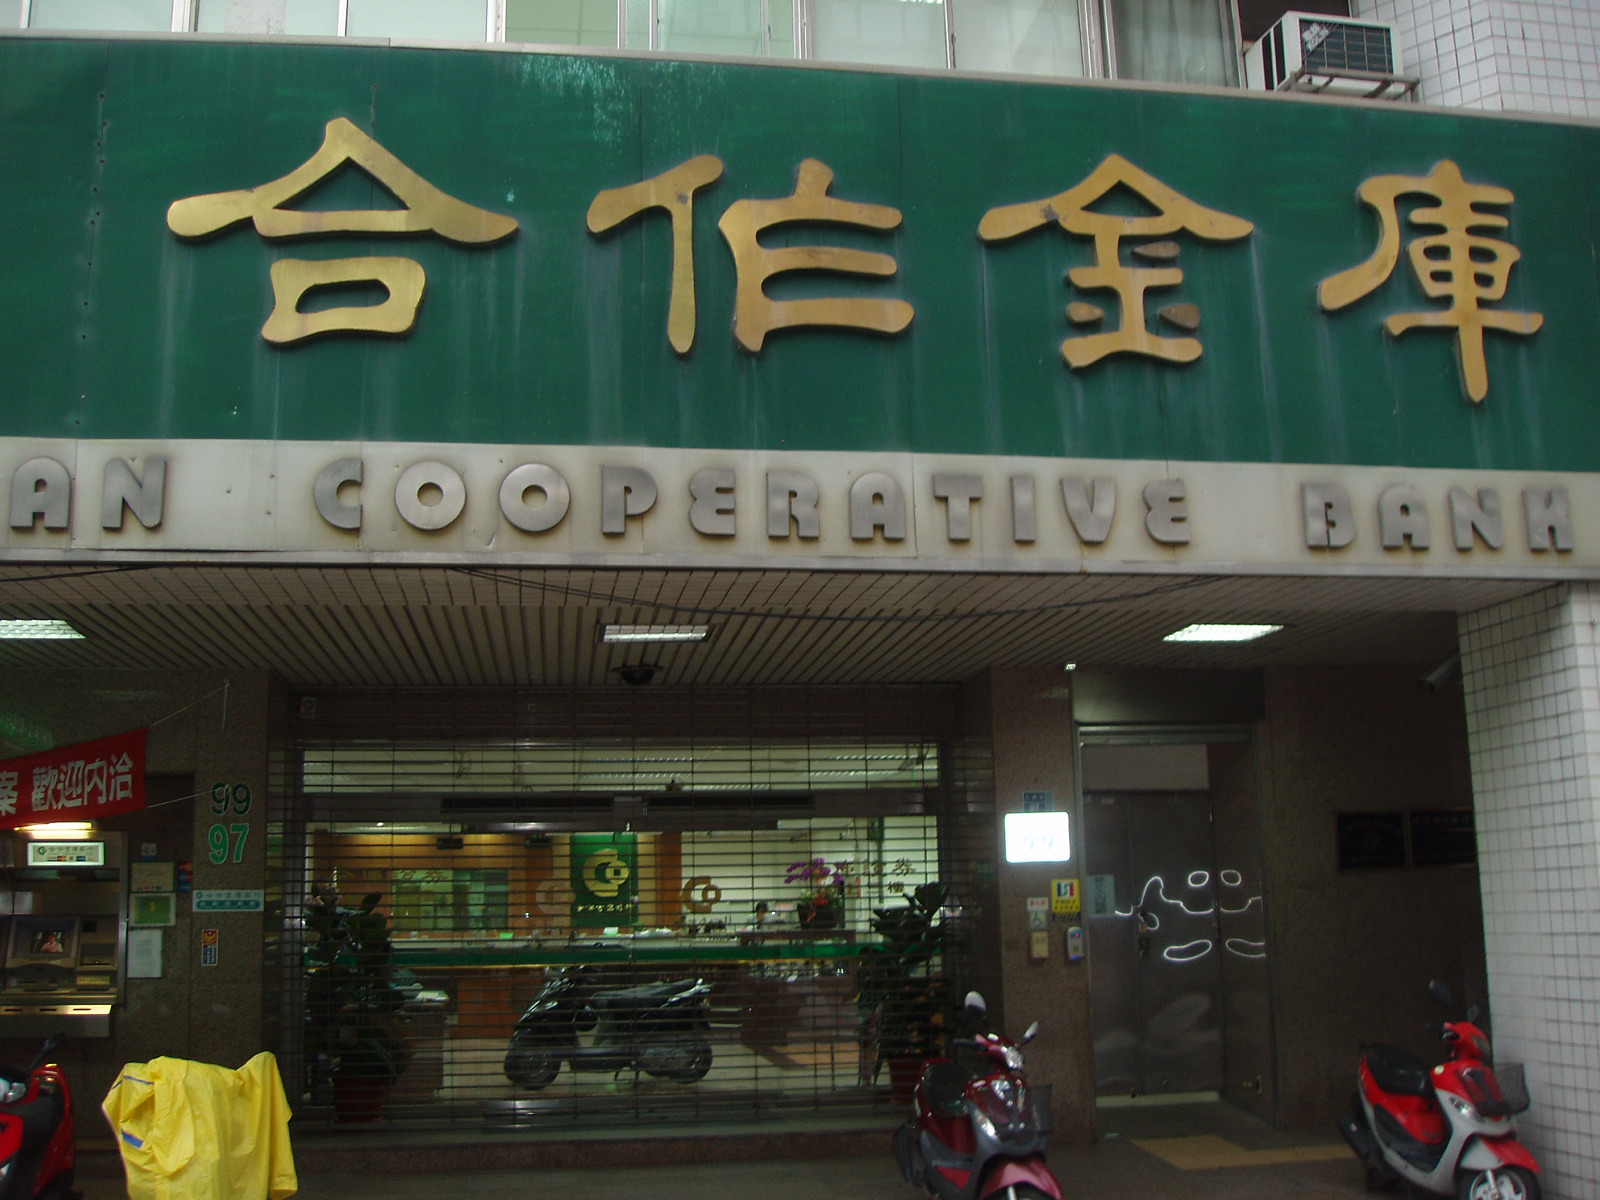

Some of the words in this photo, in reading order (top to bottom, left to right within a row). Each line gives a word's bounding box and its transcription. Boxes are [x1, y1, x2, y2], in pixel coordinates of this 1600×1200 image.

[167, 117, 1543, 403] 合作金庫
[10, 456, 168, 531] AN
[314, 458, 1191, 544] COOPERATIVE
[1301, 481, 1574, 552] BANK
[211, 782, 251, 816] 99
[208, 823, 250, 865] 97
[1024, 833, 1055, 852] 99
